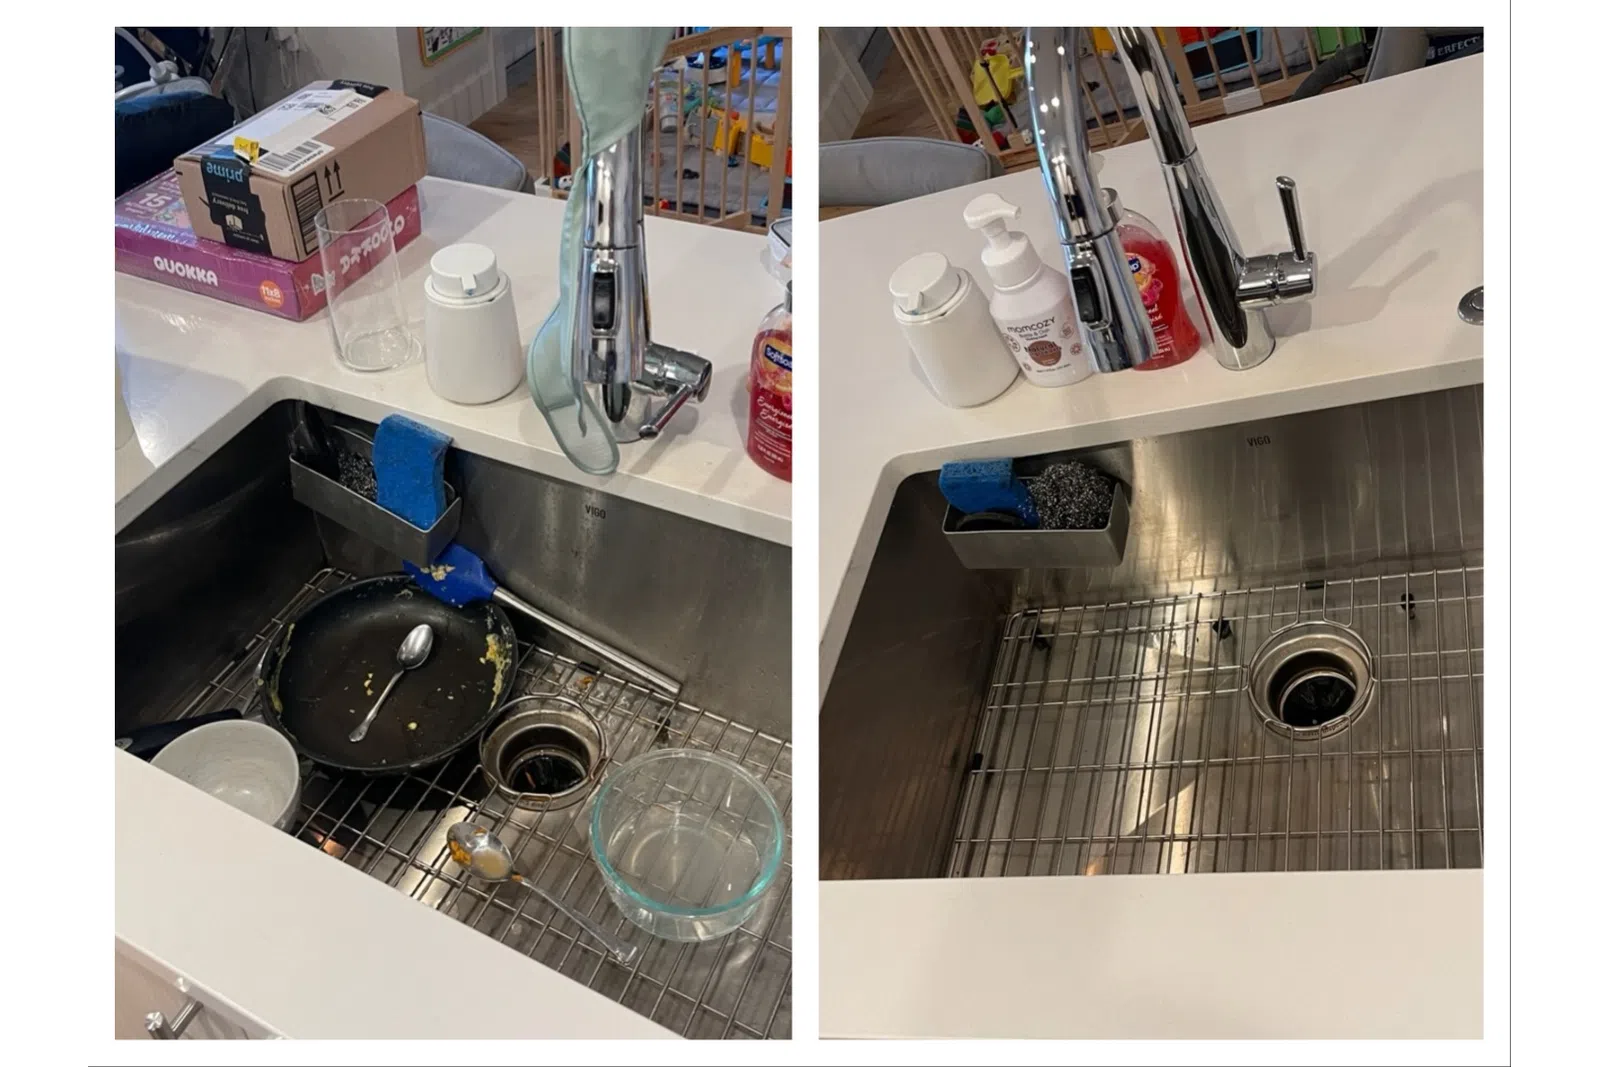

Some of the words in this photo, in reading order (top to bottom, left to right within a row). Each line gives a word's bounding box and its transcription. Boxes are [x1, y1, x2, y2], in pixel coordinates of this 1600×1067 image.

[206, 162, 243, 183] prime
[138, 192, 172, 208] 15
[153, 256, 218, 287] QUOKKA
[1246, 435, 1271, 447] VIGO
[585, 504, 606, 519] VIGO
